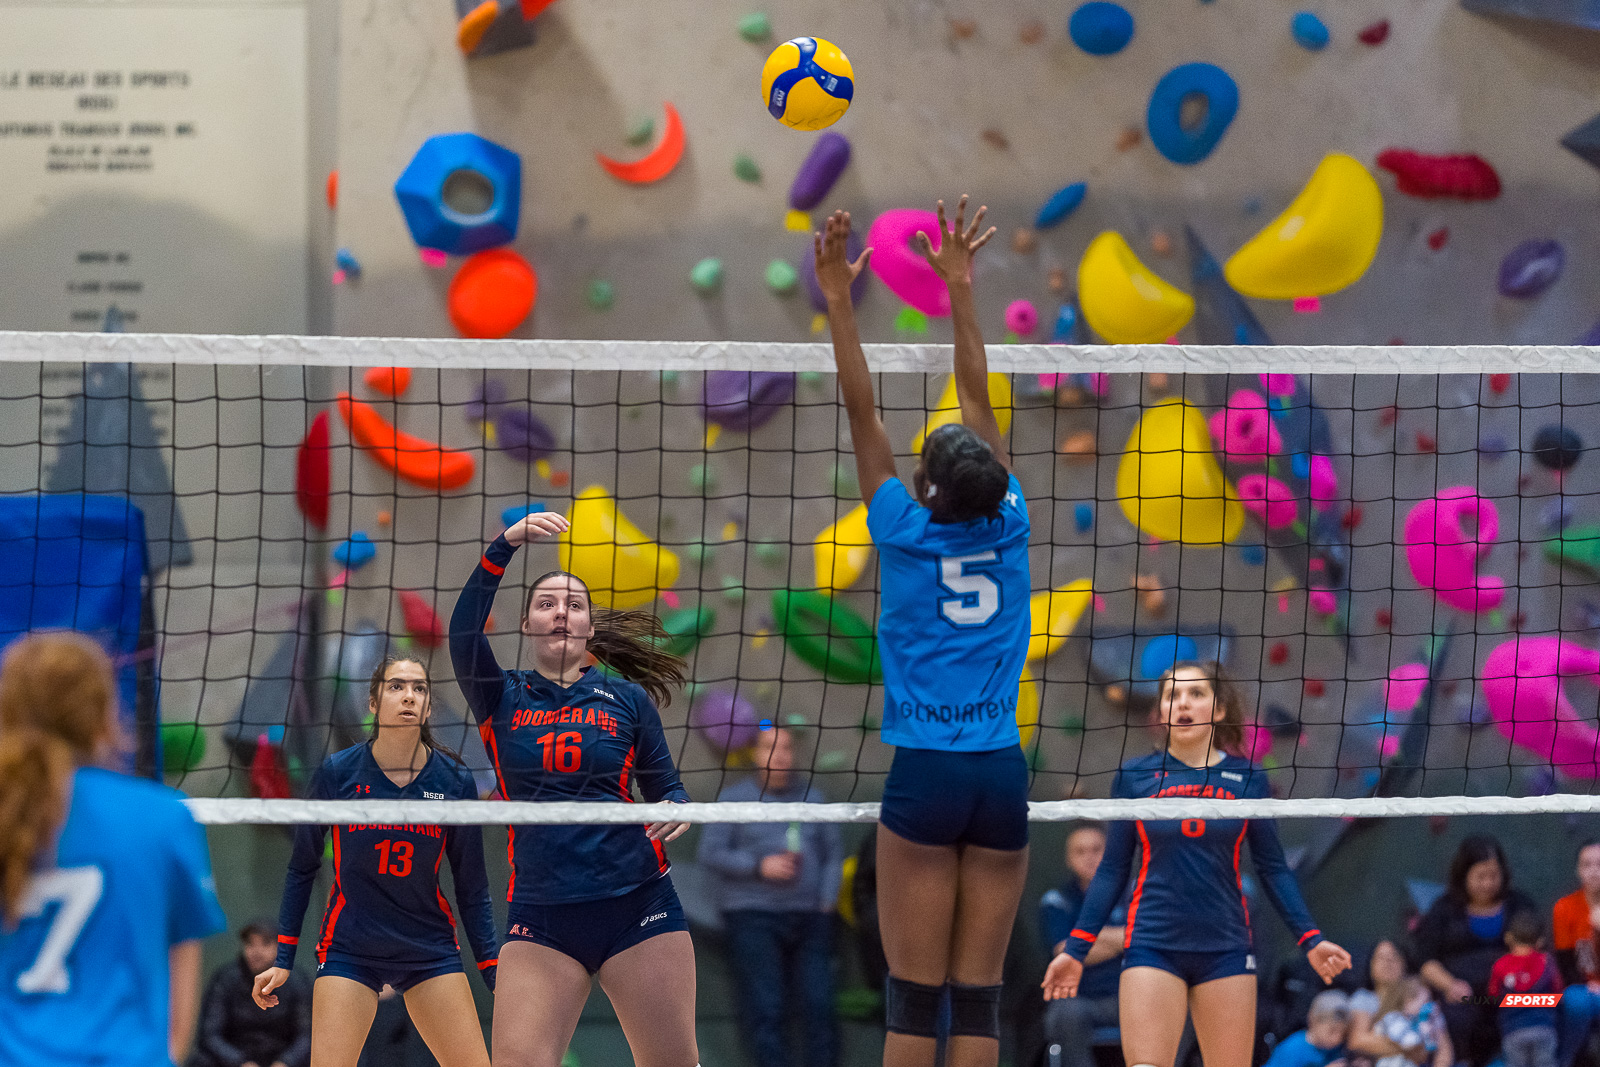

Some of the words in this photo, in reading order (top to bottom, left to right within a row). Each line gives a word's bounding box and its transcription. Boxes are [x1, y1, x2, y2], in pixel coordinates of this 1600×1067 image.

[939, 549, 1001, 627] 5
[536, 731, 583, 773] 16
[423, 791, 445, 800] RSEQ
[374, 839, 414, 877] 13
[15, 863, 104, 995] 7
